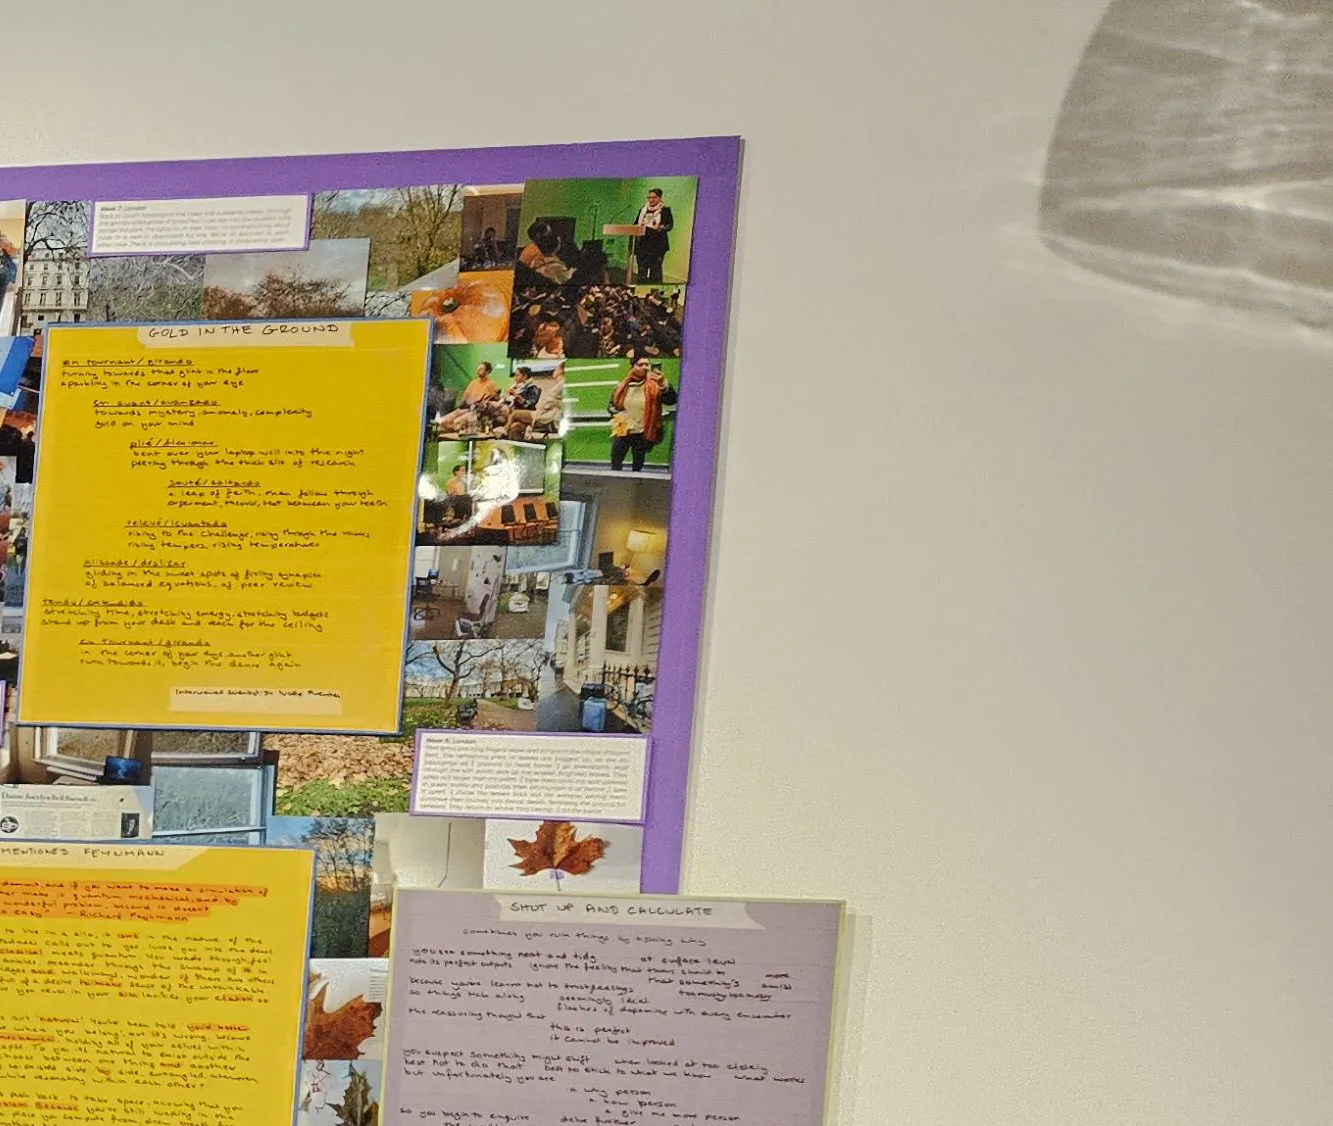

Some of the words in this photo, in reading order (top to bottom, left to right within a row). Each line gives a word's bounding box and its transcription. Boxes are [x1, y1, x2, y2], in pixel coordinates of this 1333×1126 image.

[149, 328, 189, 338] GOLD
[199, 327, 215, 336] IN
[221, 325, 253, 334] THE
[262, 324, 339, 335] GROUND
[103, 369, 145, 377] towards
[223, 379, 245, 390] eye
[1, 847, 69, 856] MENTIONED
[510, 902, 548, 912] SHUT
[557, 904, 574, 912] UP
[586, 903, 619, 915] AND
[627, 904, 713, 916] CALCULATE
[462, 927, 518, 938] sometimes
[525, 930, 543, 941] you
[575, 931, 609, 945] things
[681, 937, 706, 947] why
[460, 949, 513, 961] something
[547, 951, 567, 960] and
[572, 951, 597, 964] tidy
[469, 1050, 527, 1063] something
[432, 1068, 513, 1084] unfortunately
[516, 1074, 535, 1085] you
[615, 1089, 652, 1097] person
[637, 1099, 677, 1109] person
